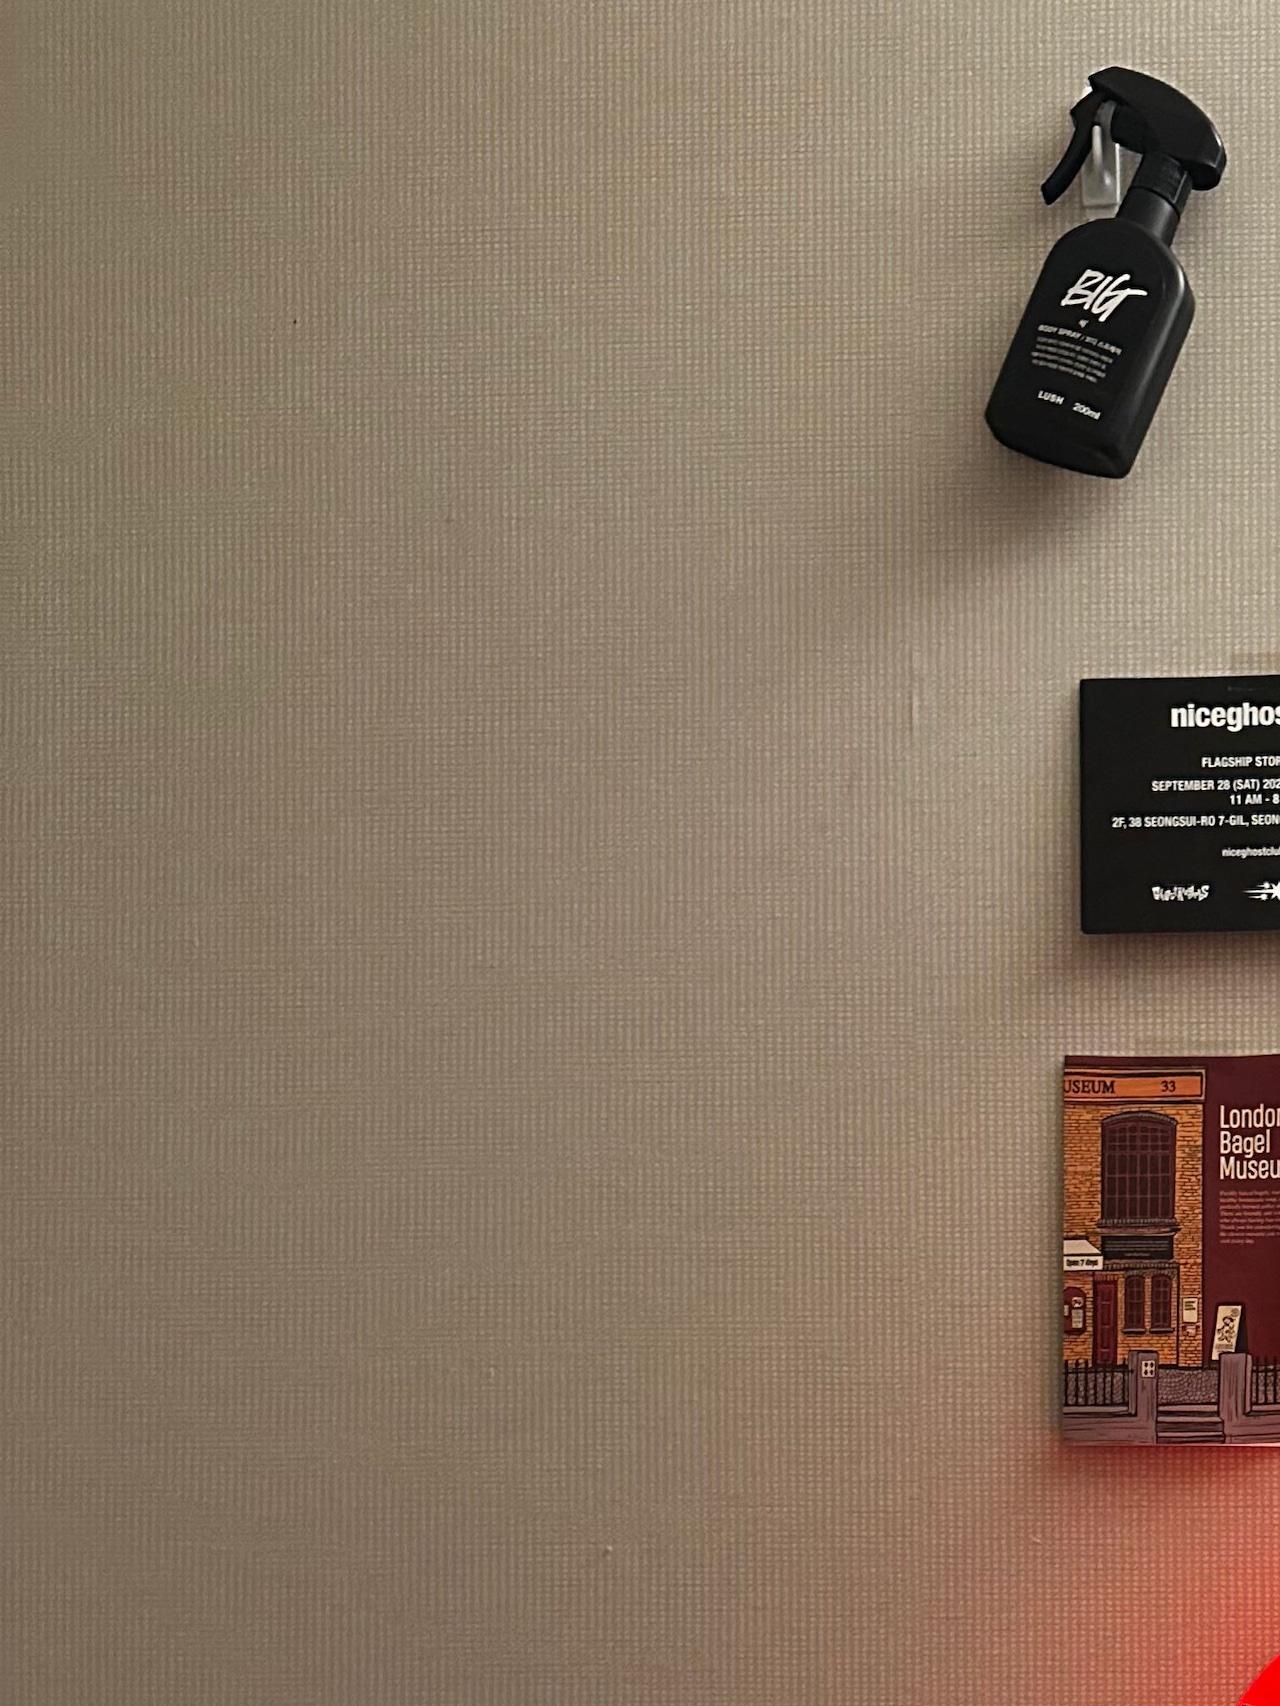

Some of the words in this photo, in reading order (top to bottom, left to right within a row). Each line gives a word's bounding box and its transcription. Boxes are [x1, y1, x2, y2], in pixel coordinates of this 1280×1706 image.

[1061, 269, 1148, 322] BIG
[1038, 390, 1064, 405] LUSH
[1073, 402, 1101, 420] 200ml
[1201, 757, 1252, 768] FLAGSHIP
[1152, 780, 1214, 791] SEPTEMBER
[1217, 780, 1231, 790] 28
[1233, 779, 1260, 791] (SAT)
[1230, 794, 1241, 805] 11
[1245, 794, 1263, 805] AM
[1272, 794, 1279, 804] 8
[1112, 817, 1126, 828] 2F,
[1144, 815, 1215, 827] SEONGSUI-RO
[1218, 815, 1249, 827] 7-GIL,
[1161, 1080, 1175, 1092] 33
[1220, 1129, 1270, 1158] Bagel
